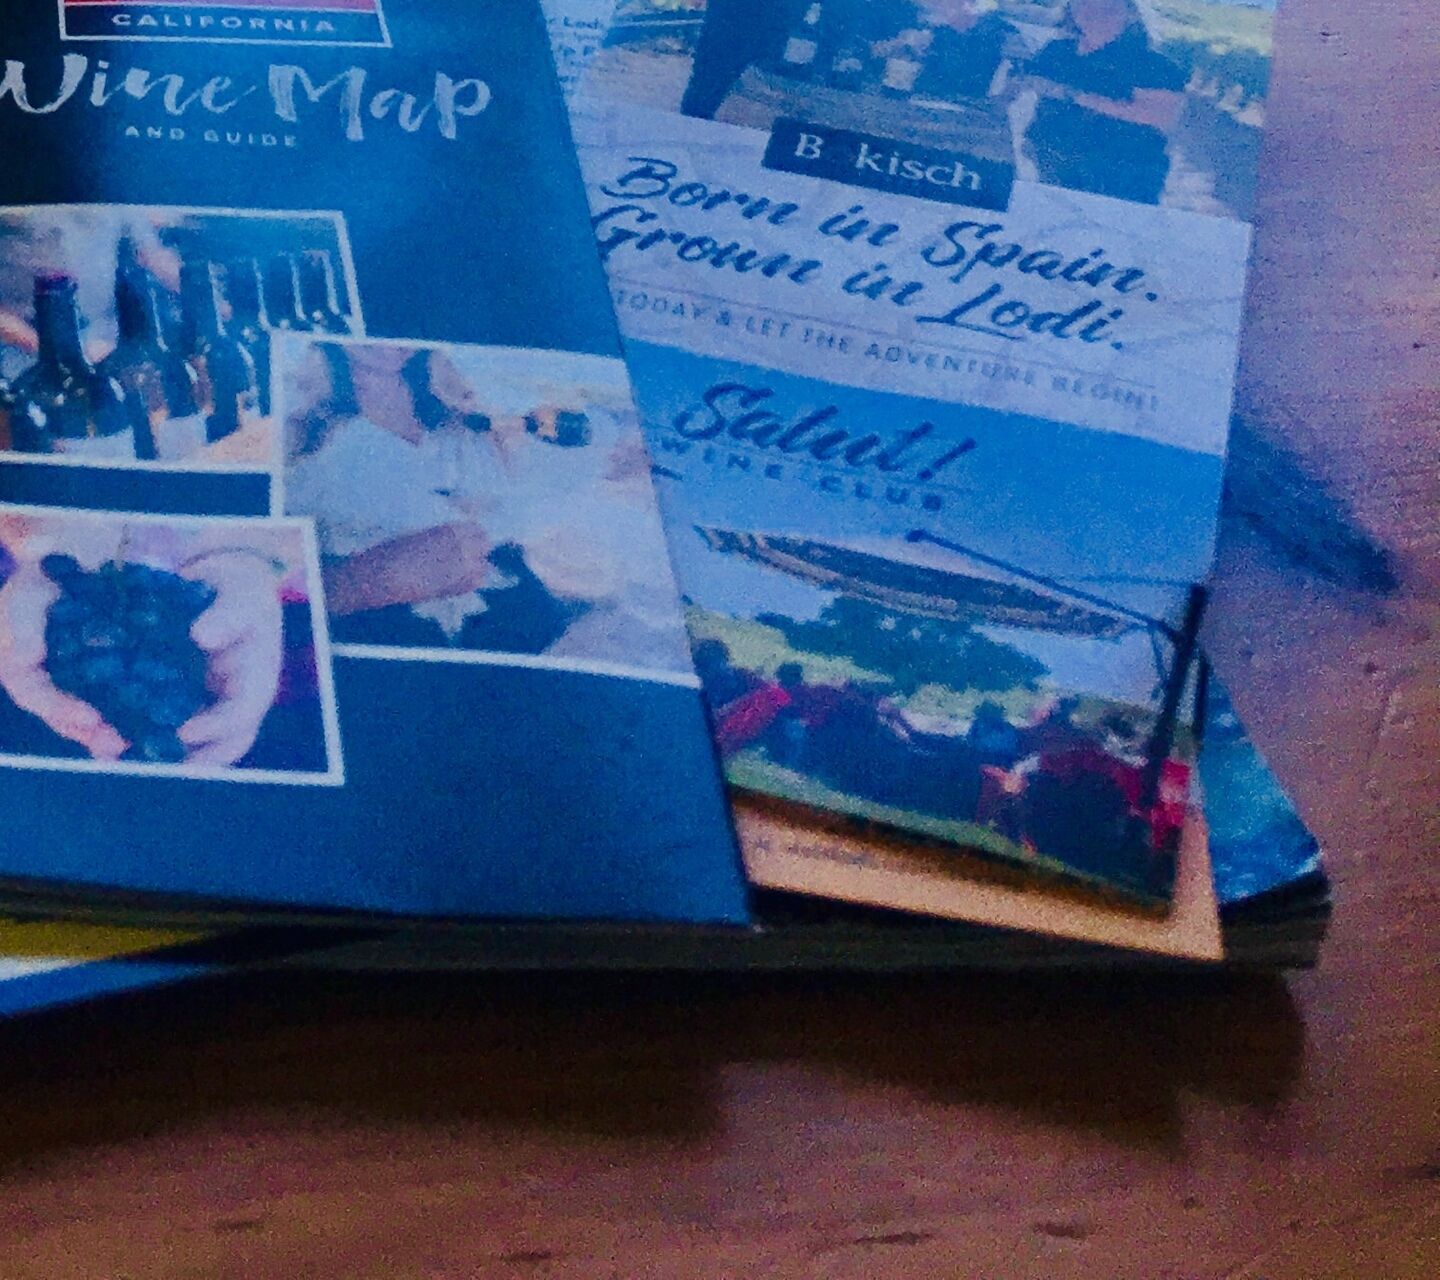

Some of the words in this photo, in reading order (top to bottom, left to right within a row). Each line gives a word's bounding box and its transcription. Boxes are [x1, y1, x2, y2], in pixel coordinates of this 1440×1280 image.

[111, 13, 336, 33] CALIFORNIA
[124, 125, 186, 141] AND
[203, 128, 298, 148] GUIDE
[268, 62, 491, 141] Map
[599, 156, 799, 225] Born
[818, 204, 901, 246] in
[920, 220, 1158, 302] Spain.
[591, 203, 823, 285] Grown
[842, 262, 924, 306] in
[915, 283, 1124, 350] Lodi.
[672, 382, 977, 481] Salut!
[819, 474, 943, 512] CLUB
